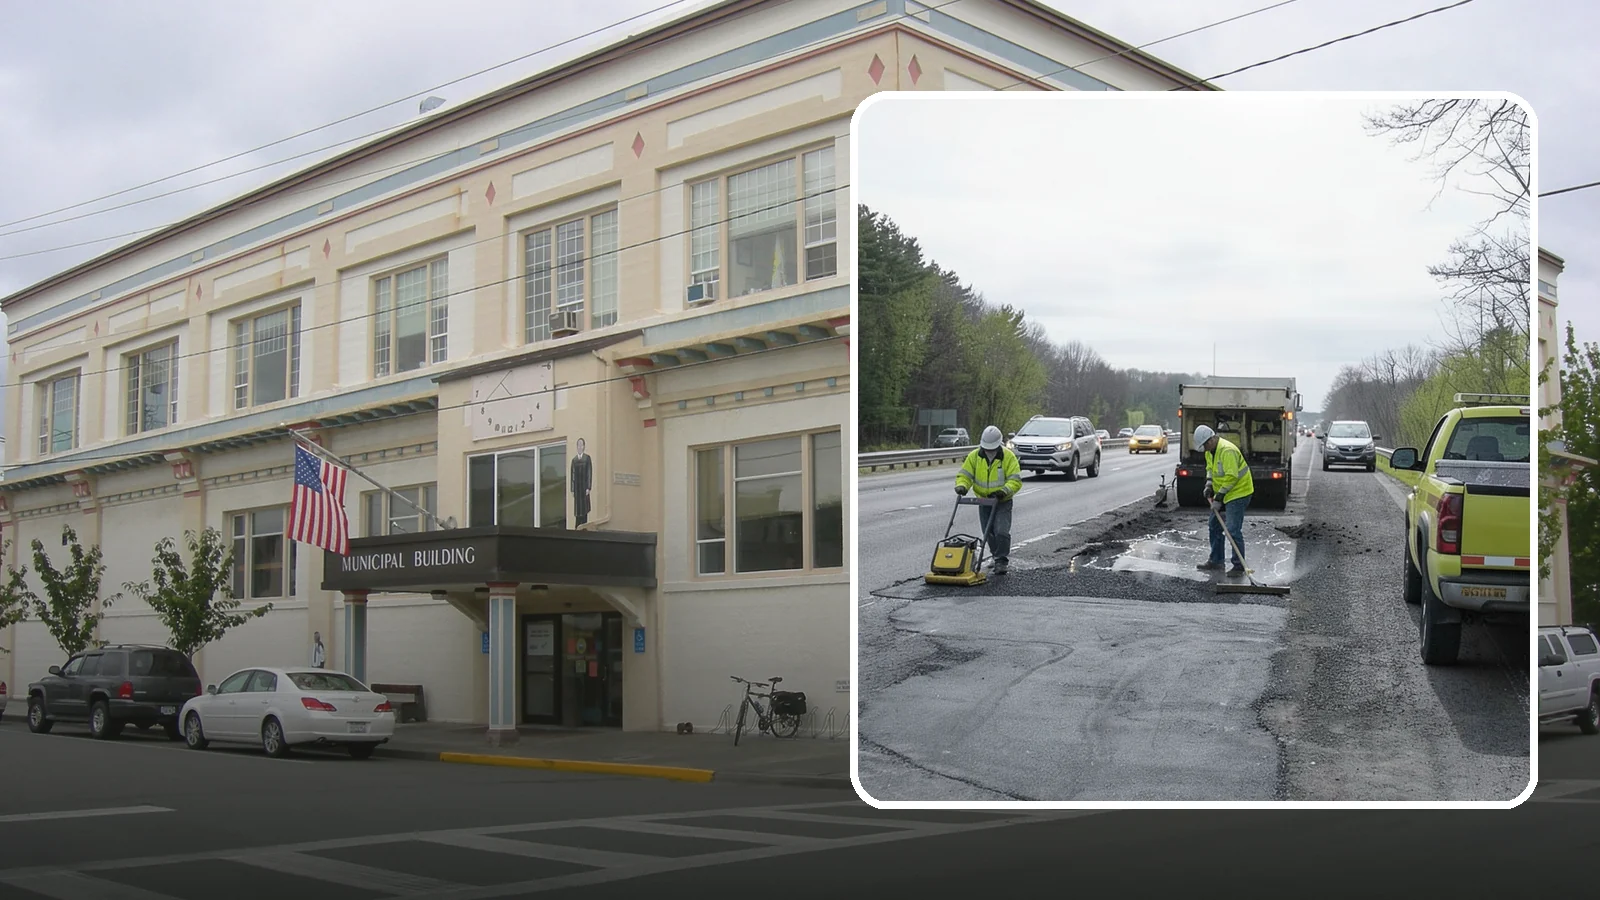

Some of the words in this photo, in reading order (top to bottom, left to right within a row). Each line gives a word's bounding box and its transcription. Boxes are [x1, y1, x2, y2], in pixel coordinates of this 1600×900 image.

[480, 407, 485, 415] 8
[487, 418, 492, 426] 9
[494, 424, 500, 432] 10
[507, 426, 513, 434] 12
[521, 420, 525, 428] 2
[529, 414, 533, 422] 3
[536, 402, 540, 410] 4
[342, 552, 405, 571] MUNICIPAL
[414, 546, 475, 566] BUILDING
